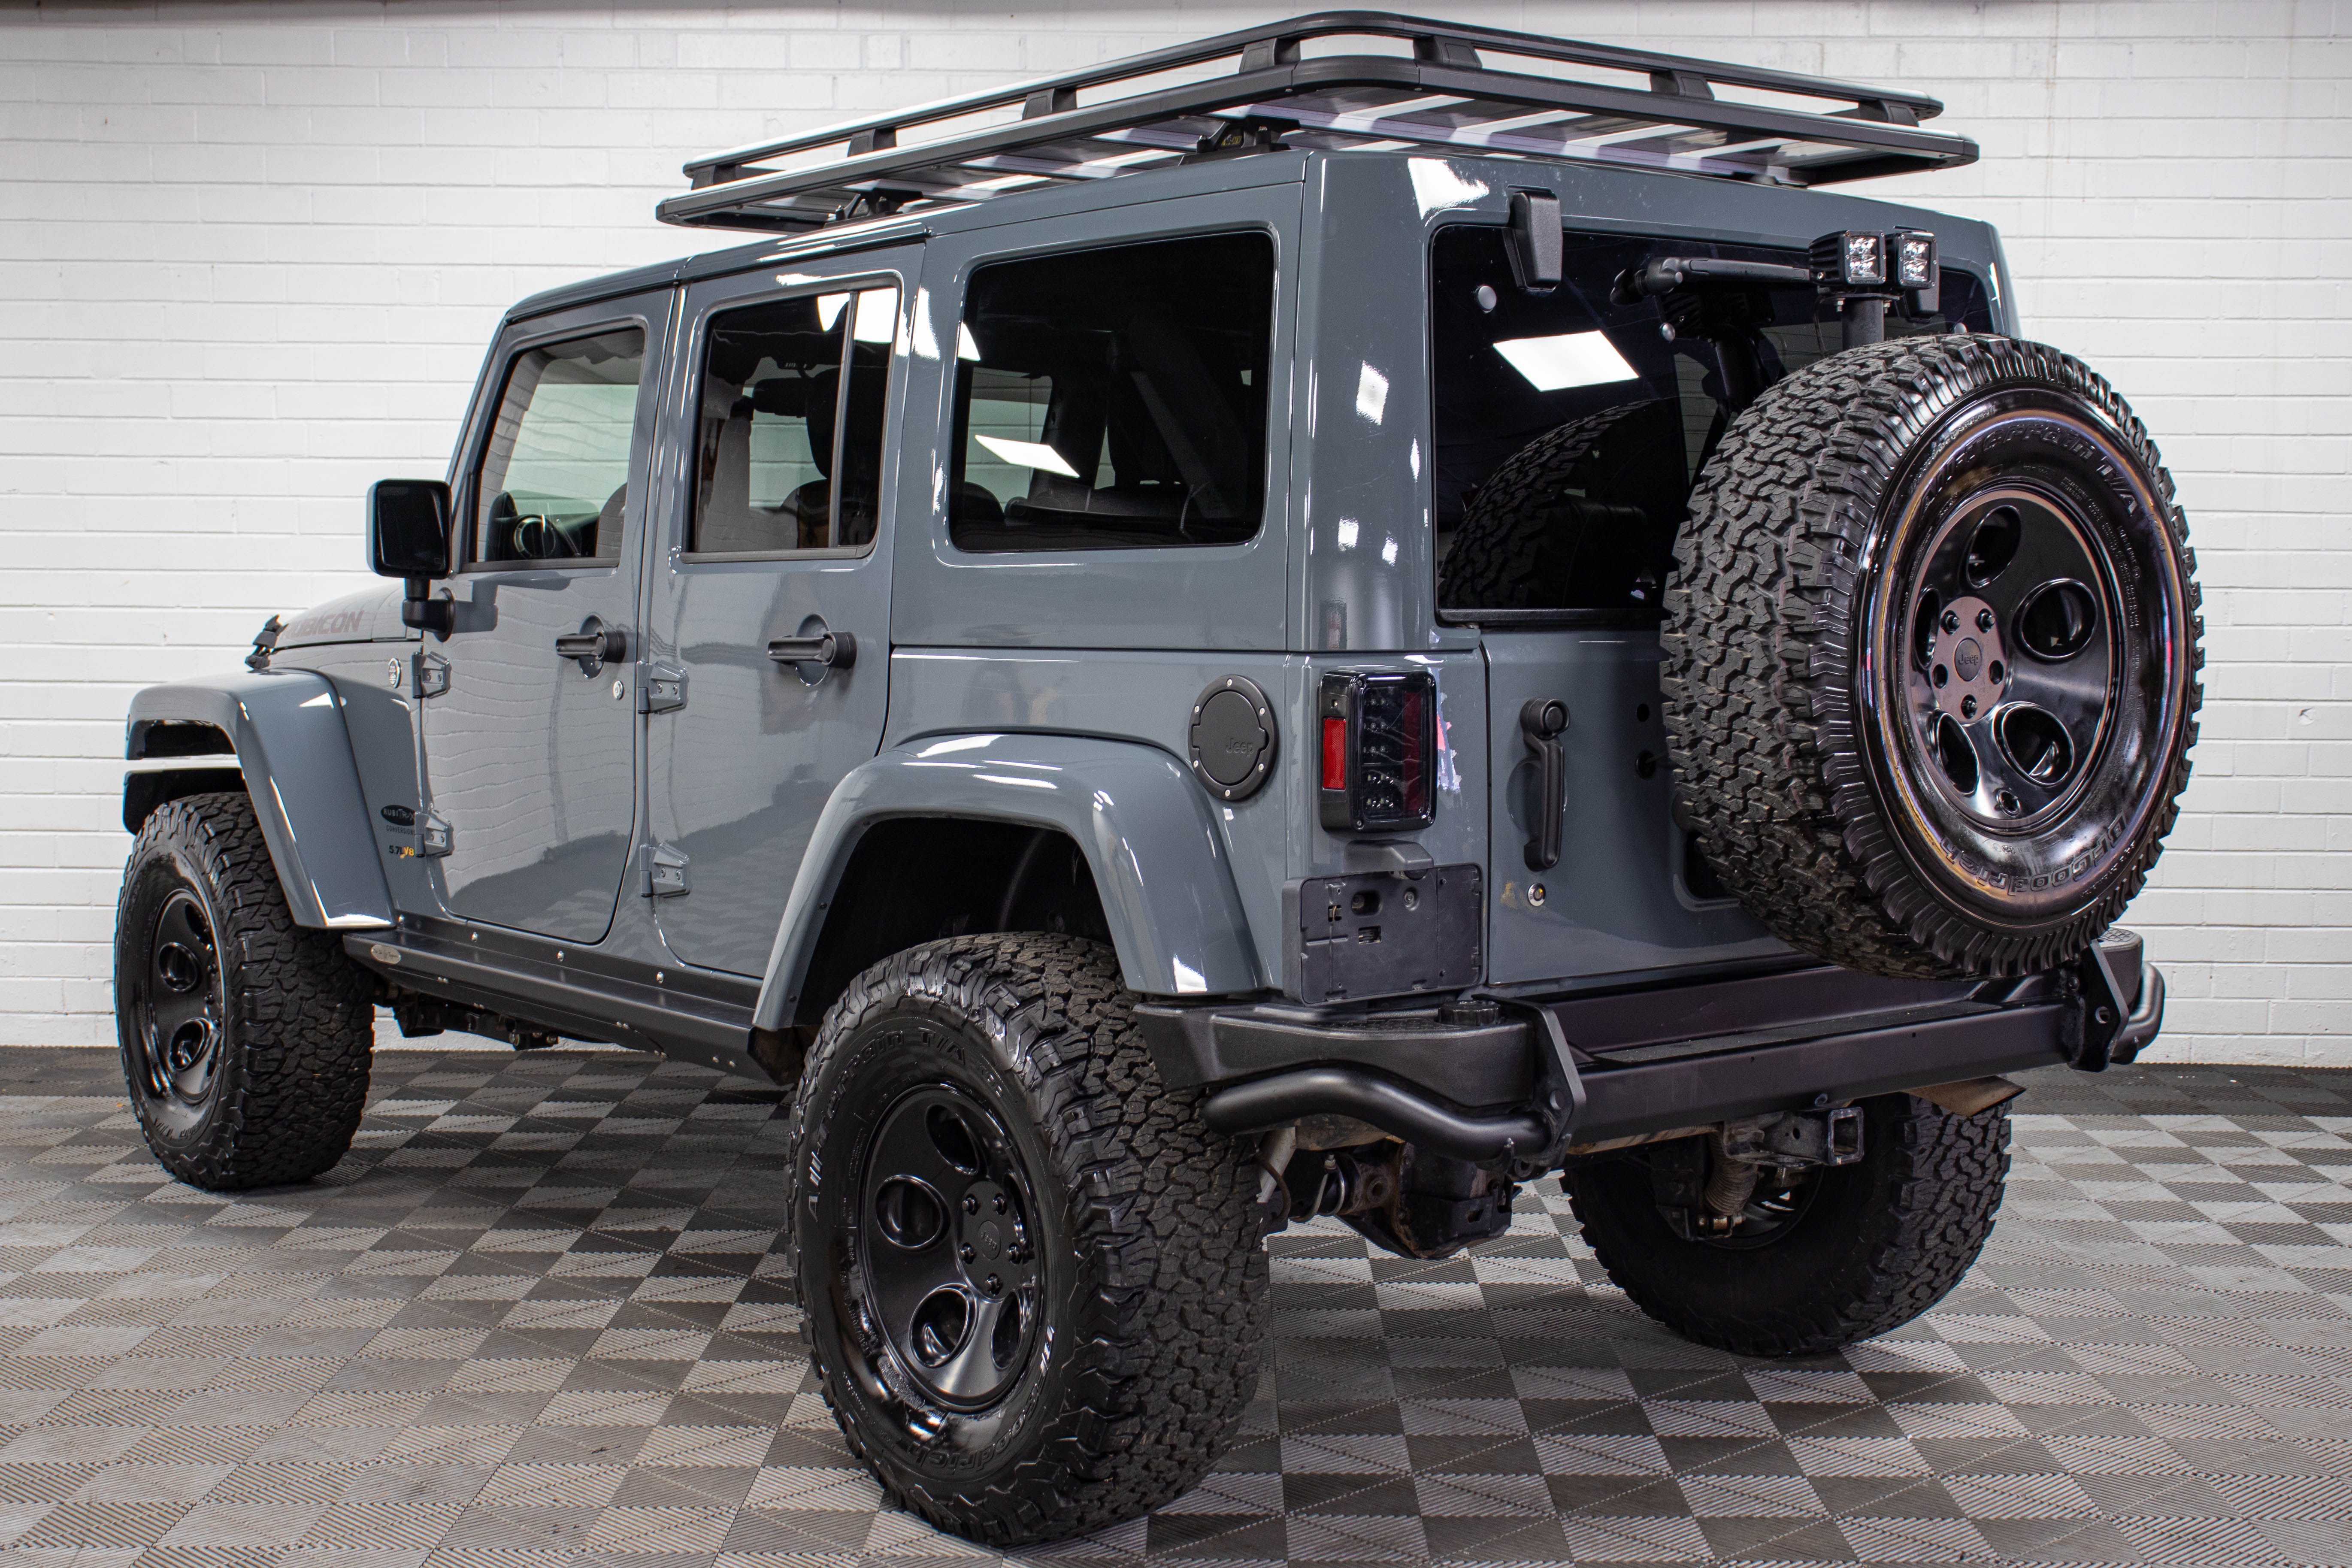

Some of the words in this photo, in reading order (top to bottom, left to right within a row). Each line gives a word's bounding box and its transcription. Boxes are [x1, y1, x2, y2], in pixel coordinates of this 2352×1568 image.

[2096, 456, 2139, 515] T/A
[1958, 654, 1979, 666] Jeep
[1226, 738, 1253, 757] Jeep
[1940, 815, 2128, 896] BFGoodrich
[918, 1027, 966, 1065] T/A
